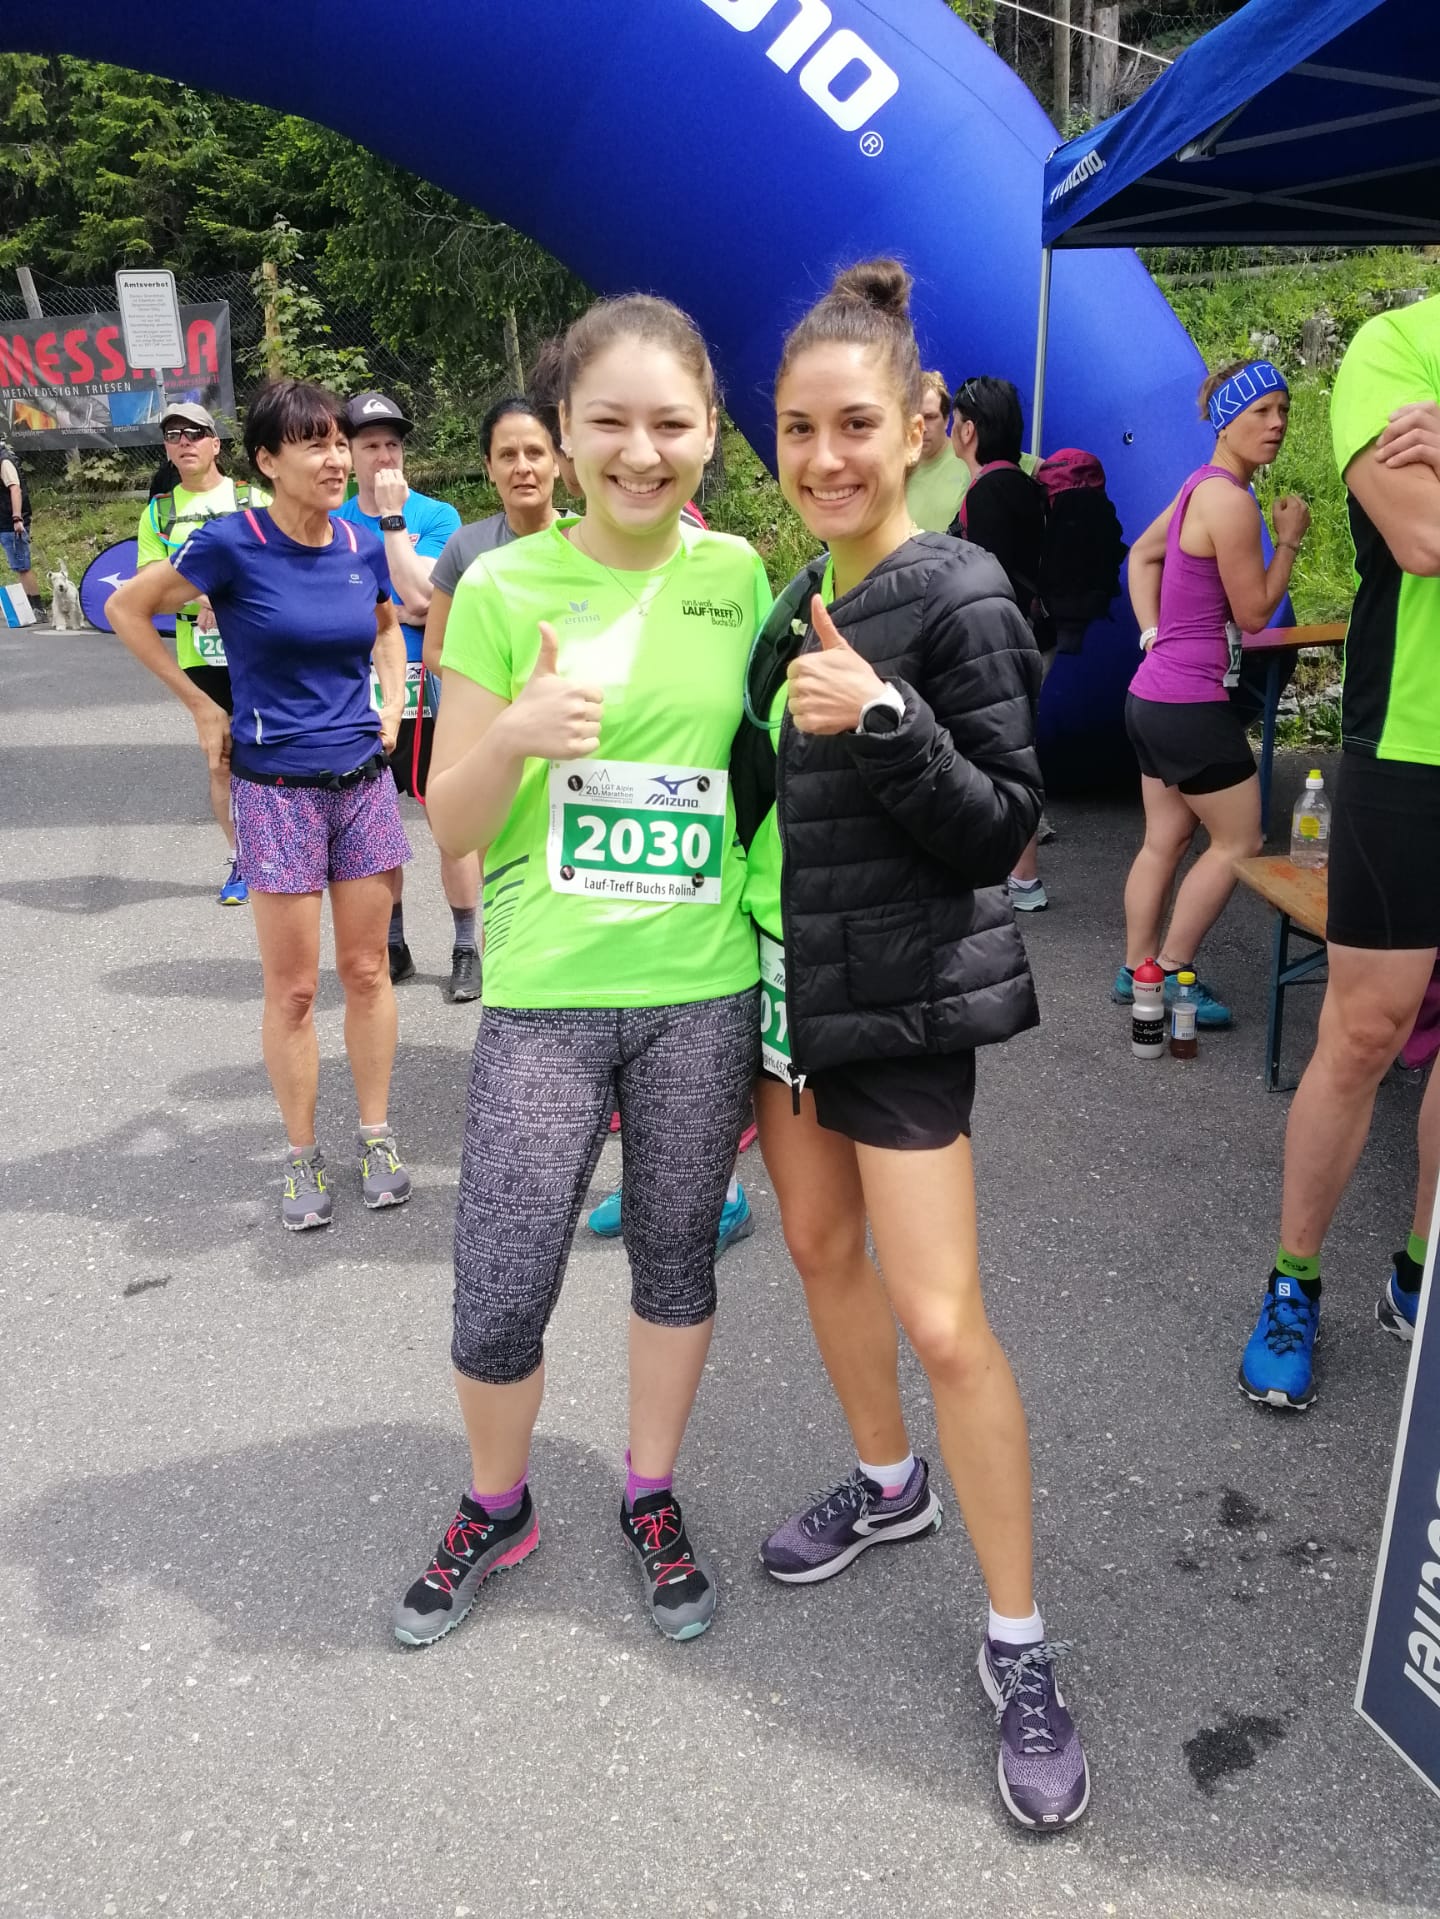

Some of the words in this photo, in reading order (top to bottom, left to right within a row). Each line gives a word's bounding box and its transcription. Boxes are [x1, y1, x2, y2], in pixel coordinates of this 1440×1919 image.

[0, 319, 219, 387] MESSA
[86, 382, 131, 394] TRIESEN
[683, 606, 734, 619] LAUF-TREFF
[601, 790, 634, 798] Marathon
[573, 814, 711, 869] 2030
[584, 876, 634, 894] Lauf-Treff
[636, 881, 666, 896] Buchs
[668, 883, 697, 897] Rolina
